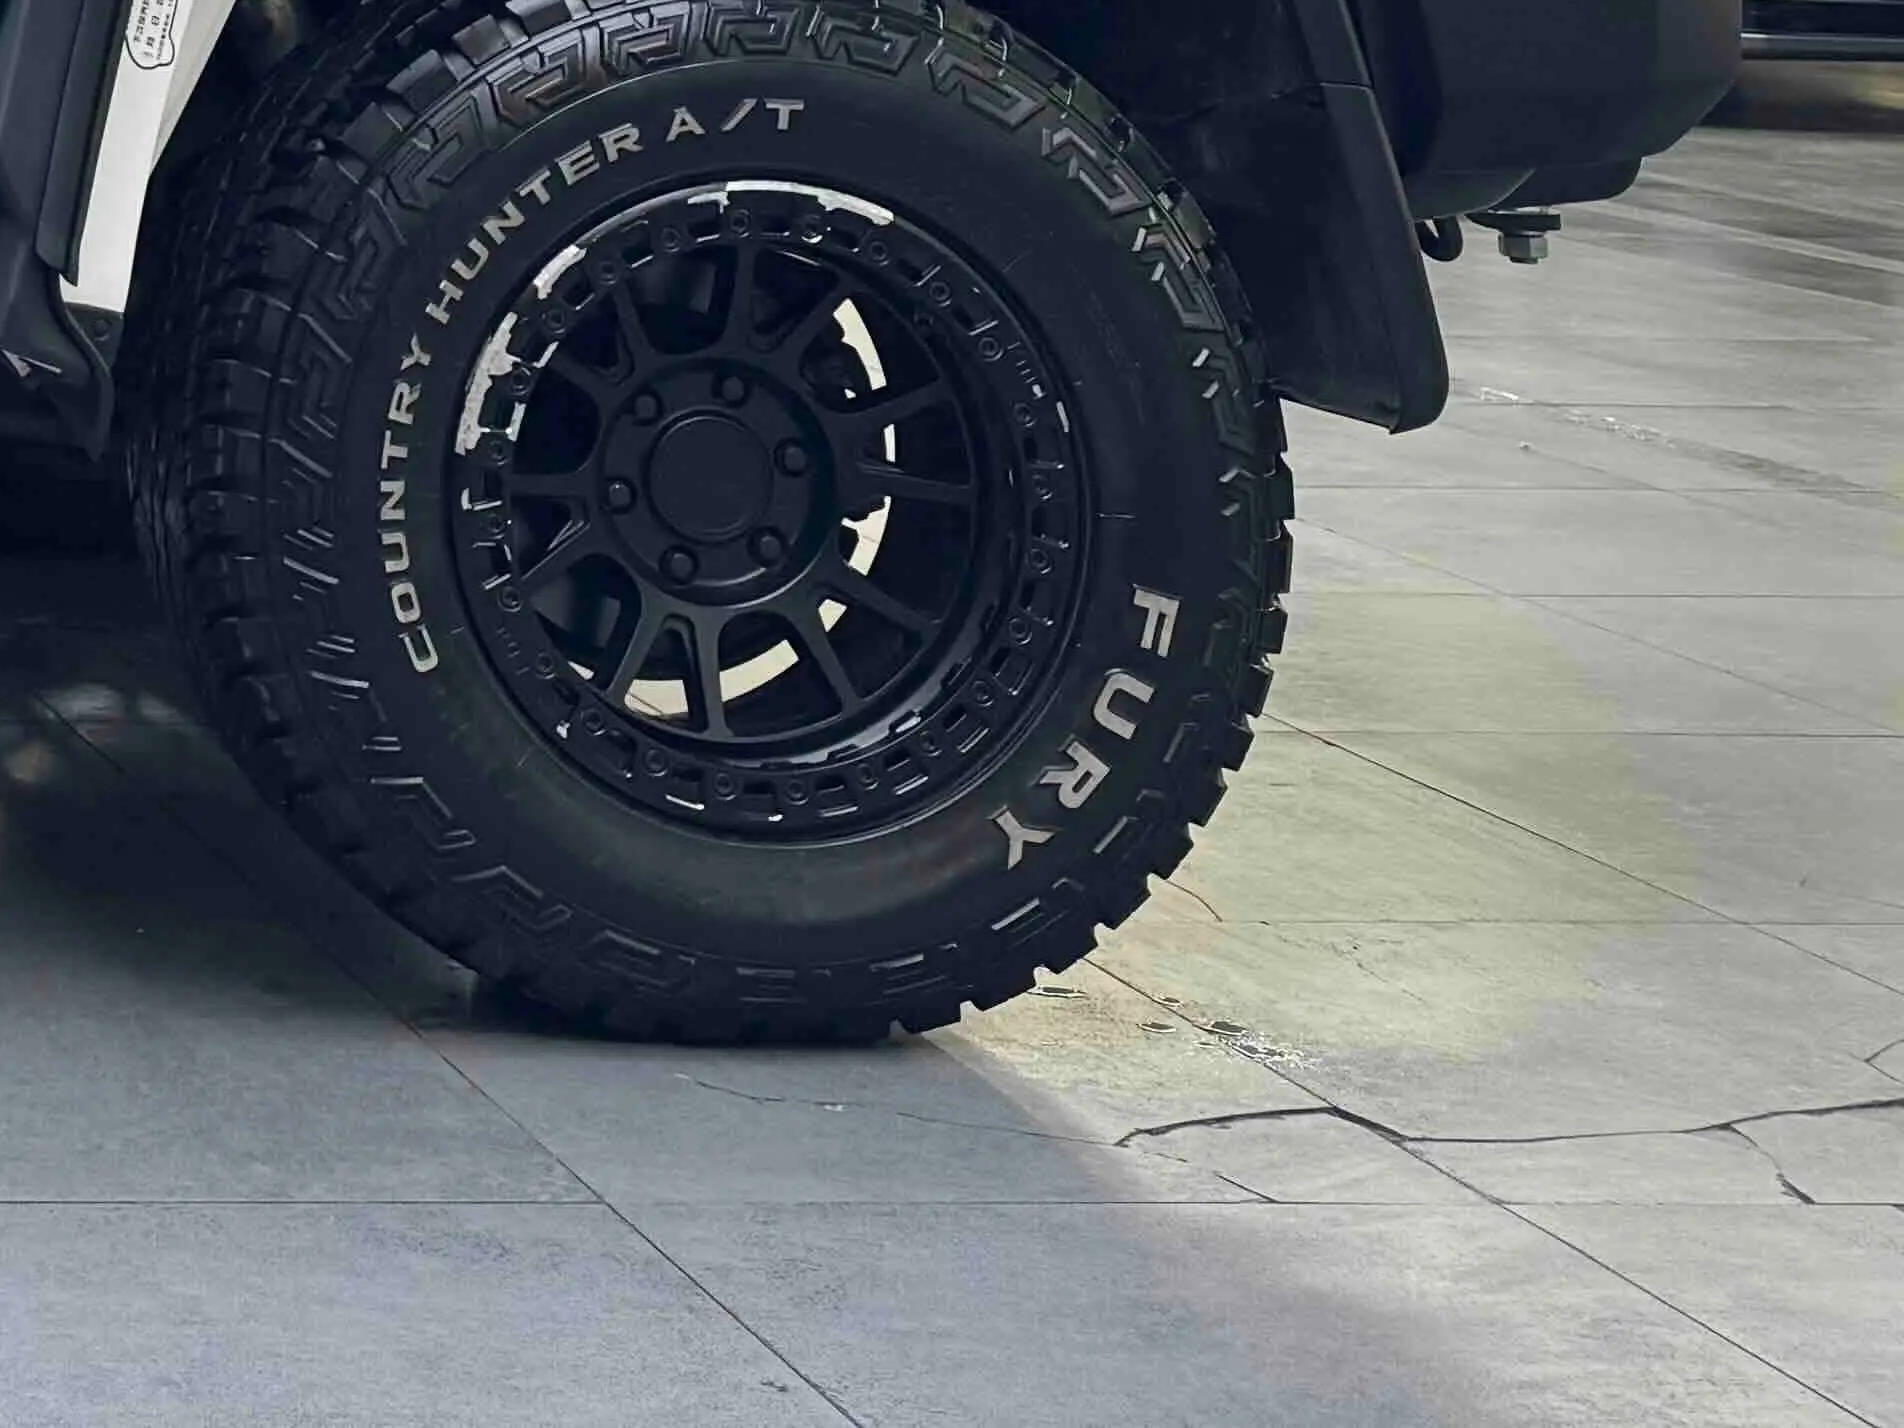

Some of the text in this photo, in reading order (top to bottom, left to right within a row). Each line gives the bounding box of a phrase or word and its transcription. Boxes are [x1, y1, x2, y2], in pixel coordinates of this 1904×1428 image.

[380, 97, 805, 673] COUNTRY HUNTER A/T
[994, 587, 1181, 864] FURY
